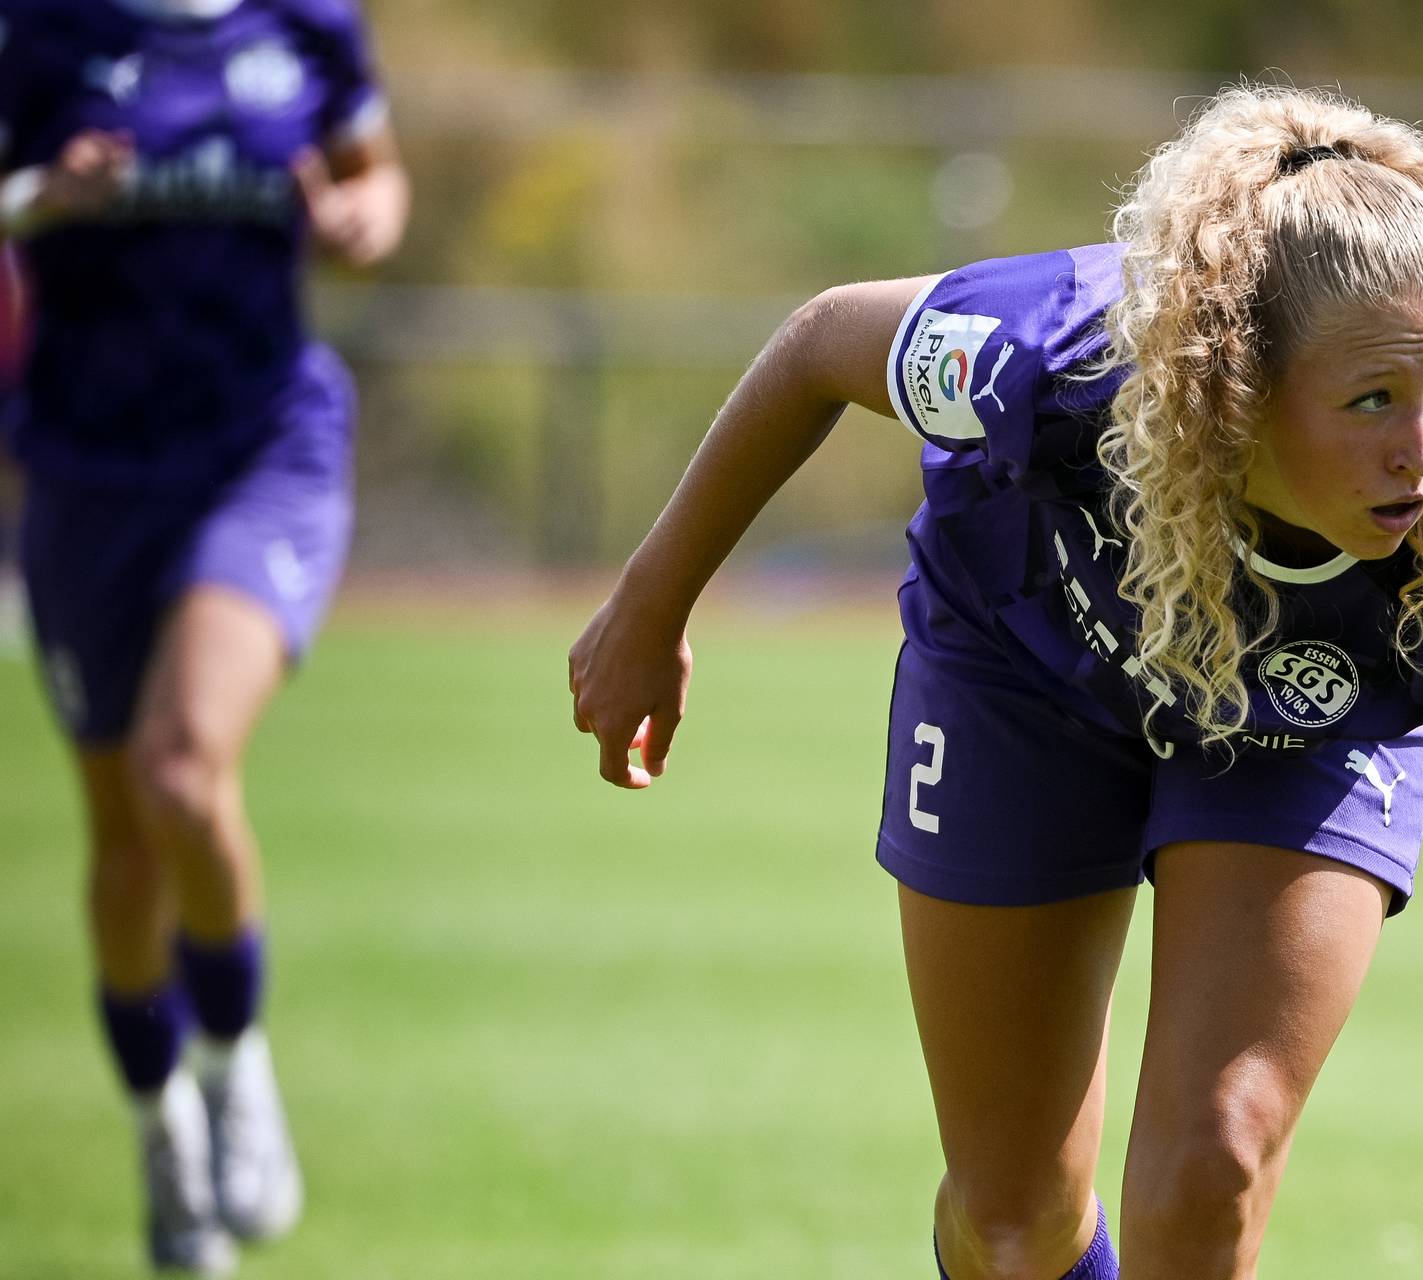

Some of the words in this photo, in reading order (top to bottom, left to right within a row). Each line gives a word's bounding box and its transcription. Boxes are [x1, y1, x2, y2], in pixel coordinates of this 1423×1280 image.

[917, 334, 945, 413] Pixel
[1274, 657, 1345, 704] SGS
[1304, 647, 1340, 670] ESSEN
[1280, 684, 1310, 715] 19/68
[909, 721, 945, 834] 2
